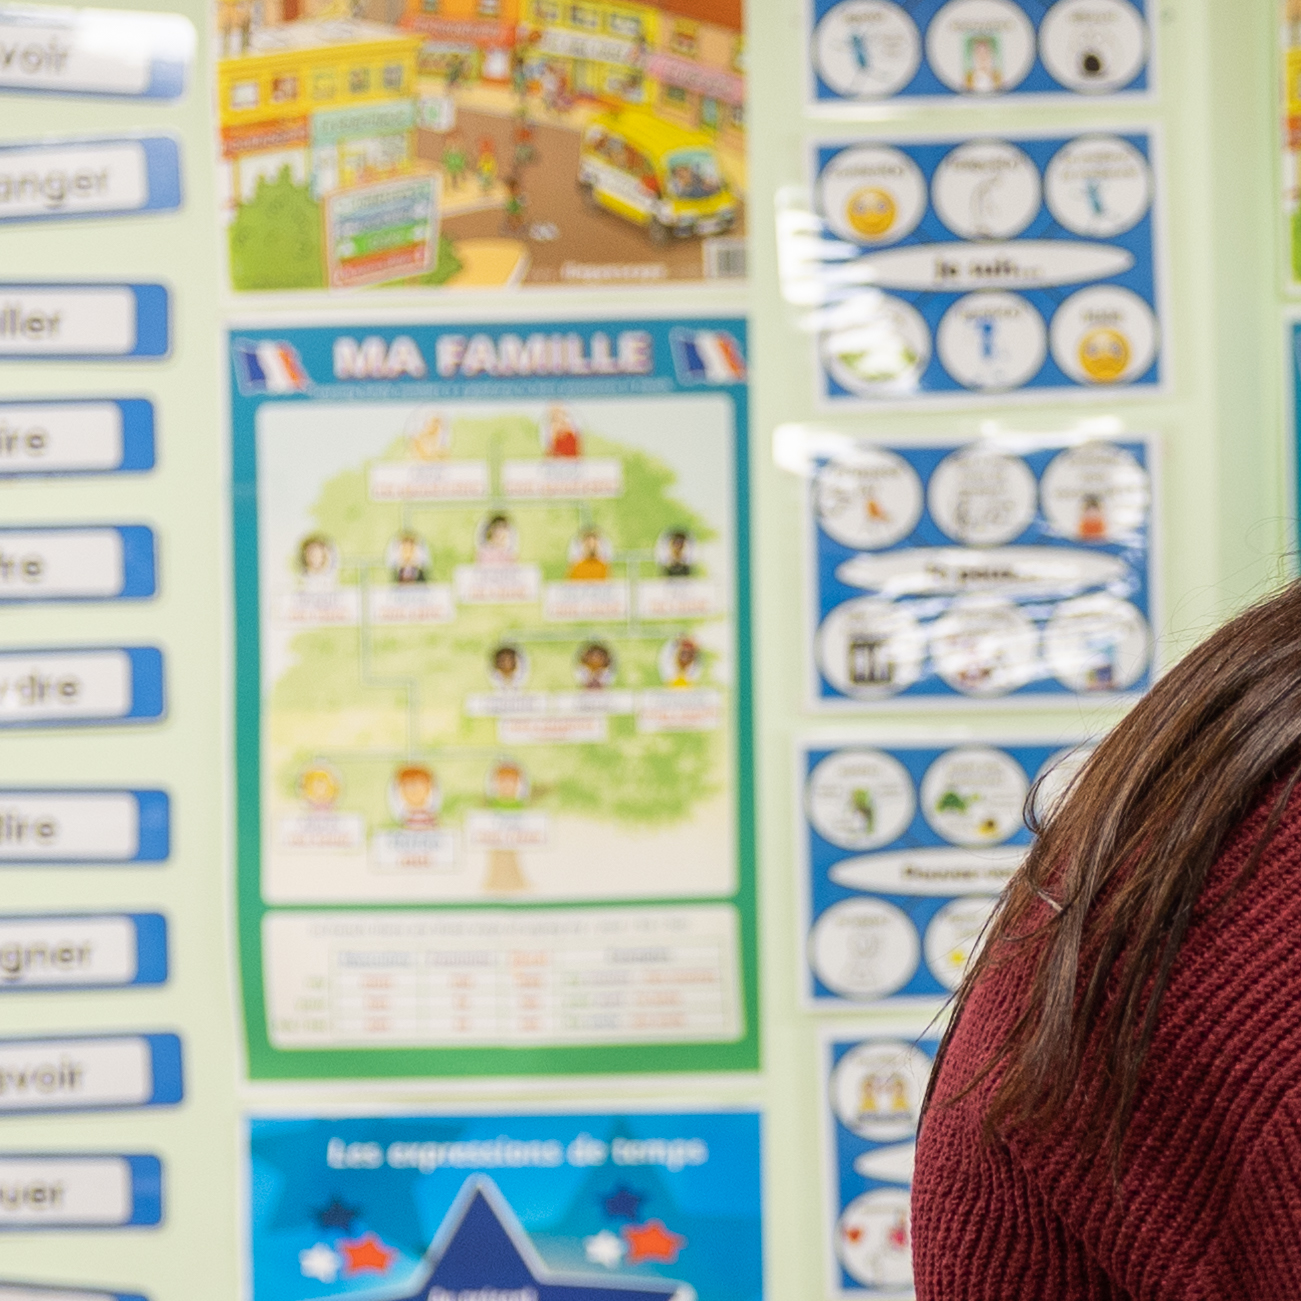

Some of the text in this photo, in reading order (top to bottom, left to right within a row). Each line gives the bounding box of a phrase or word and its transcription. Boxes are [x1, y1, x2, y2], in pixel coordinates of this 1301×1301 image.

[333, 330, 653, 379] MA FAMILLE
[326, 1132, 710, 1175] Les expressions de temps
